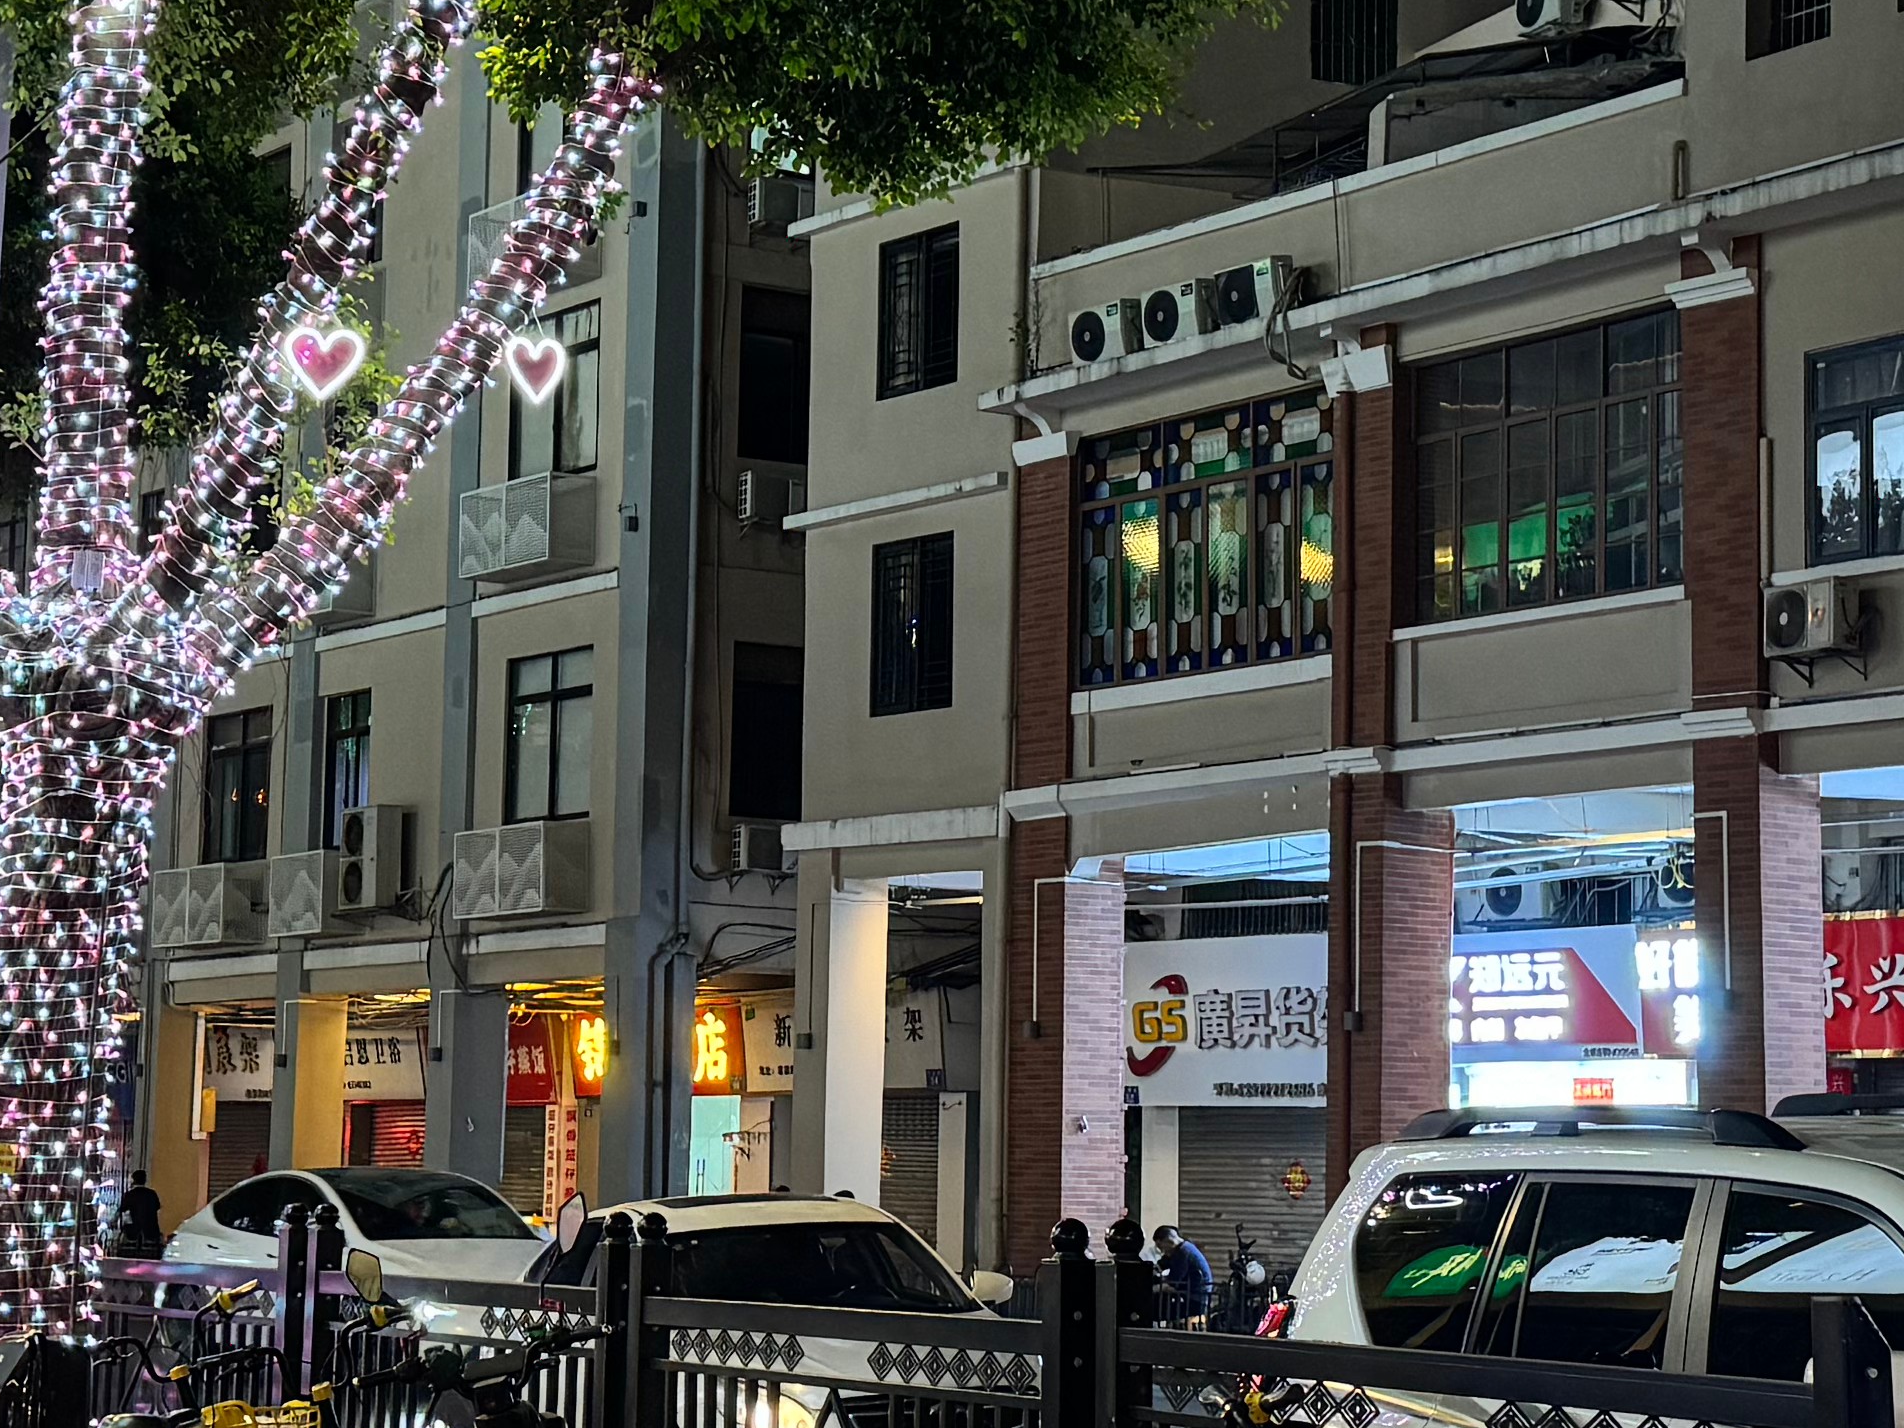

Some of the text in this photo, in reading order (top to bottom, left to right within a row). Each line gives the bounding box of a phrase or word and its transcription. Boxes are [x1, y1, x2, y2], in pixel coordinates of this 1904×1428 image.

[693, 1011, 729, 1083] 店
[1132, 999, 1188, 1043] GS
[1193, 987, 1328, 1050] 廣昇货
